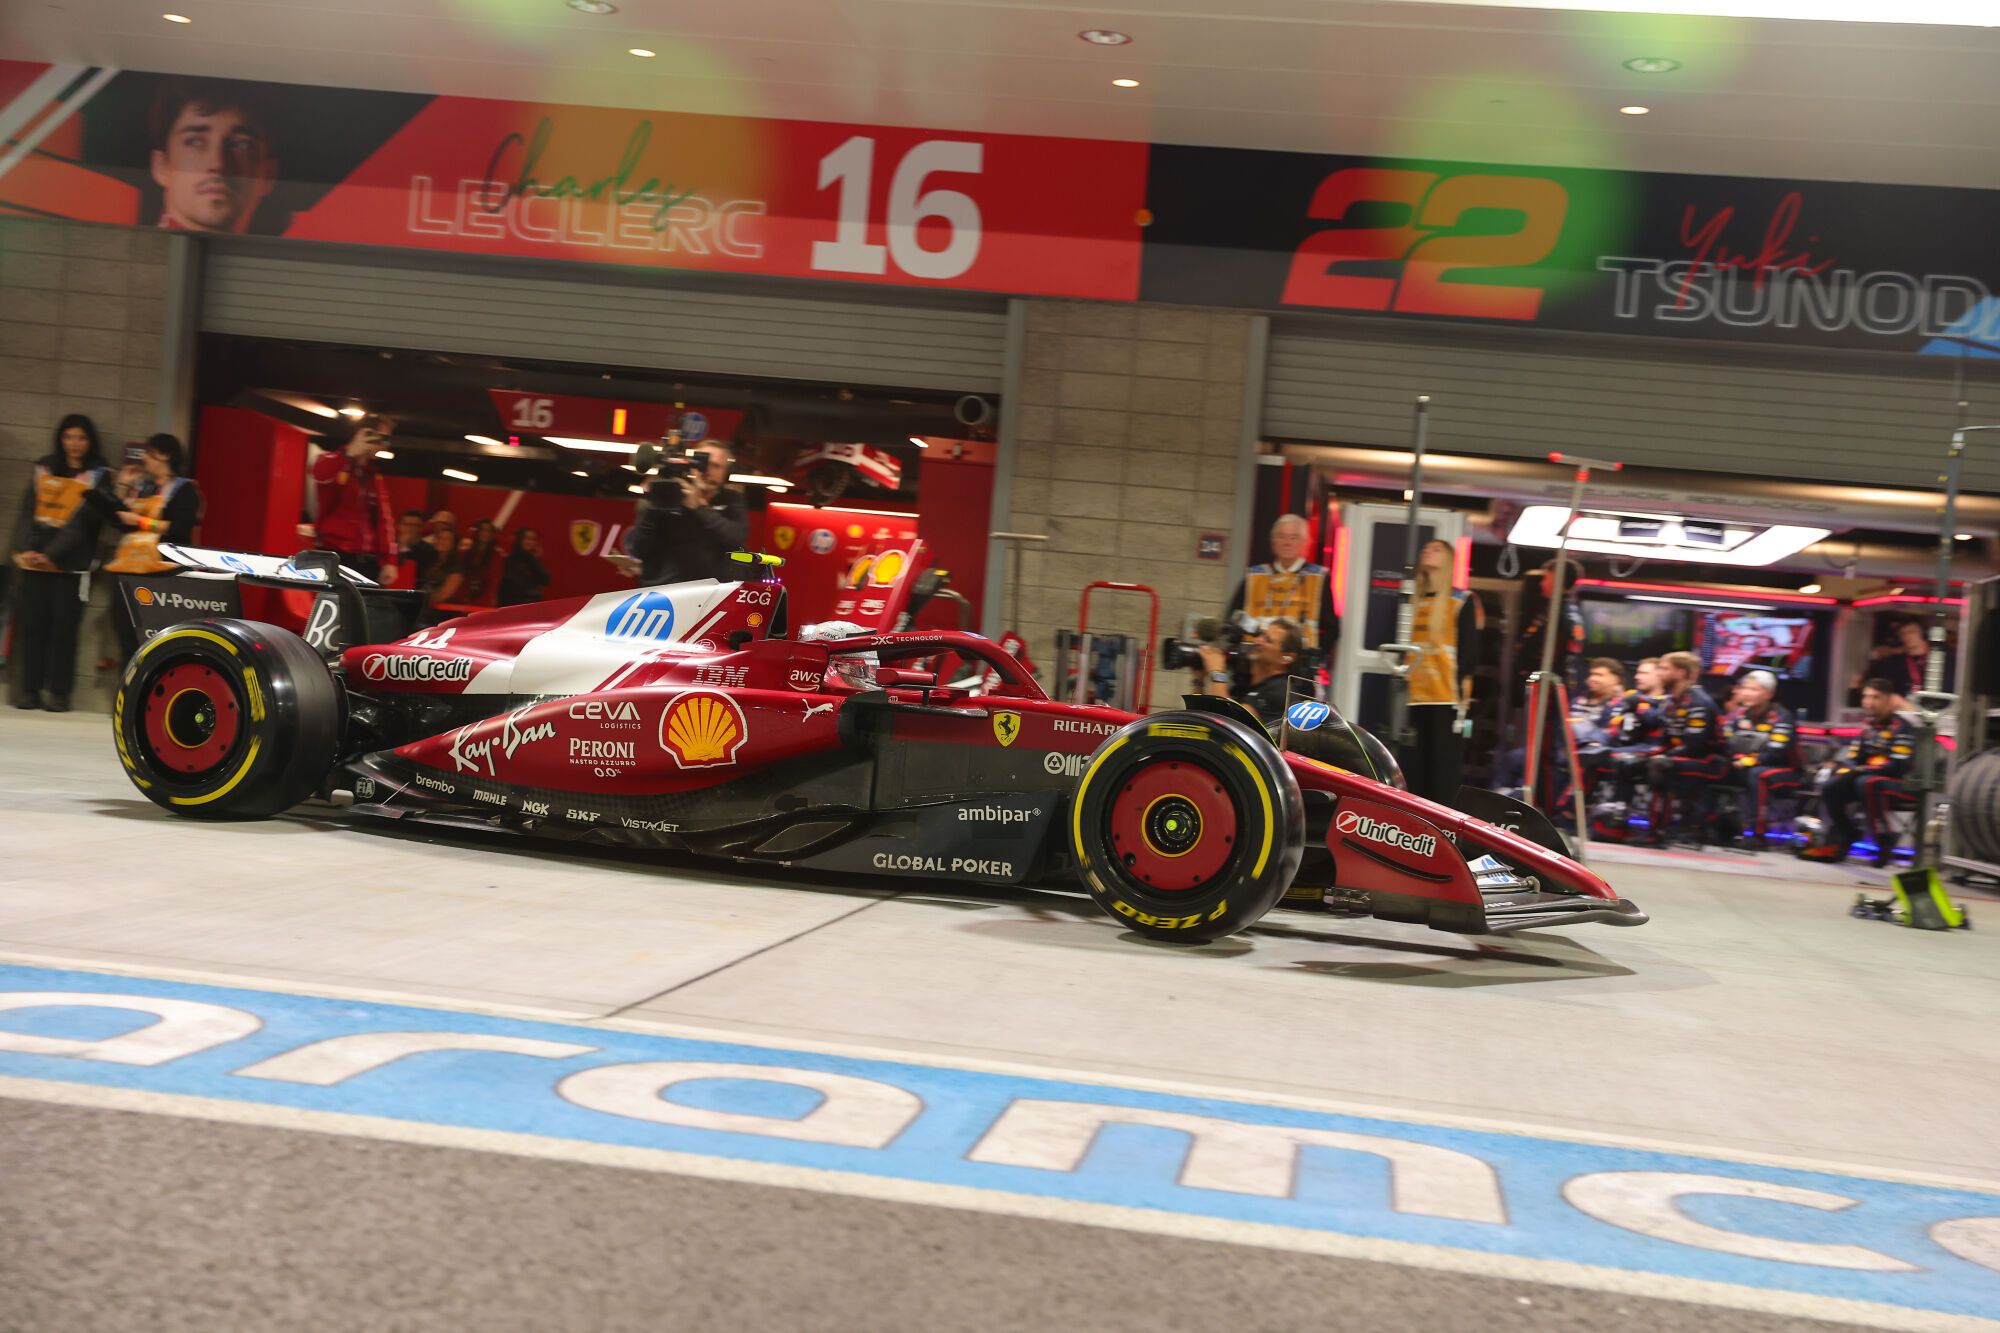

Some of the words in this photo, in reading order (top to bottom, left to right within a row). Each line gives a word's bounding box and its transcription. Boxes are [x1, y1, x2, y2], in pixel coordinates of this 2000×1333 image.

[407, 174, 767, 259] LECLERC
[810, 135, 985, 280] 16
[1281, 167, 1570, 321] 22
[1676, 190, 1837, 313] Yuki
[511, 398, 554, 429] 16
[154, 592, 228, 612] V-Power
[736, 589, 771, 606] ZCG
[896, 634, 943, 643] TECHNOLOGY
[386, 655, 473, 681] UniCredit
[691, 664, 750, 687] IBM
[790, 668, 821, 684] aws
[600, 722, 641, 730] LOGISTICS
[1290, 702, 1327, 730] hp
[569, 737, 635, 759] PERONI
[416, 773, 456, 795] brembo
[472, 789, 507, 807] MAHLE
[522, 800, 550, 816] NGK
[566, 808, 601, 822] SKF
[957, 806, 1031, 825] ambipar
[1358, 816, 1437, 857] UniCredit
[872, 853, 946, 872] GLOBAL
[951, 858, 1013, 877] POKER
[1110, 899, 1202, 929] ZERO
